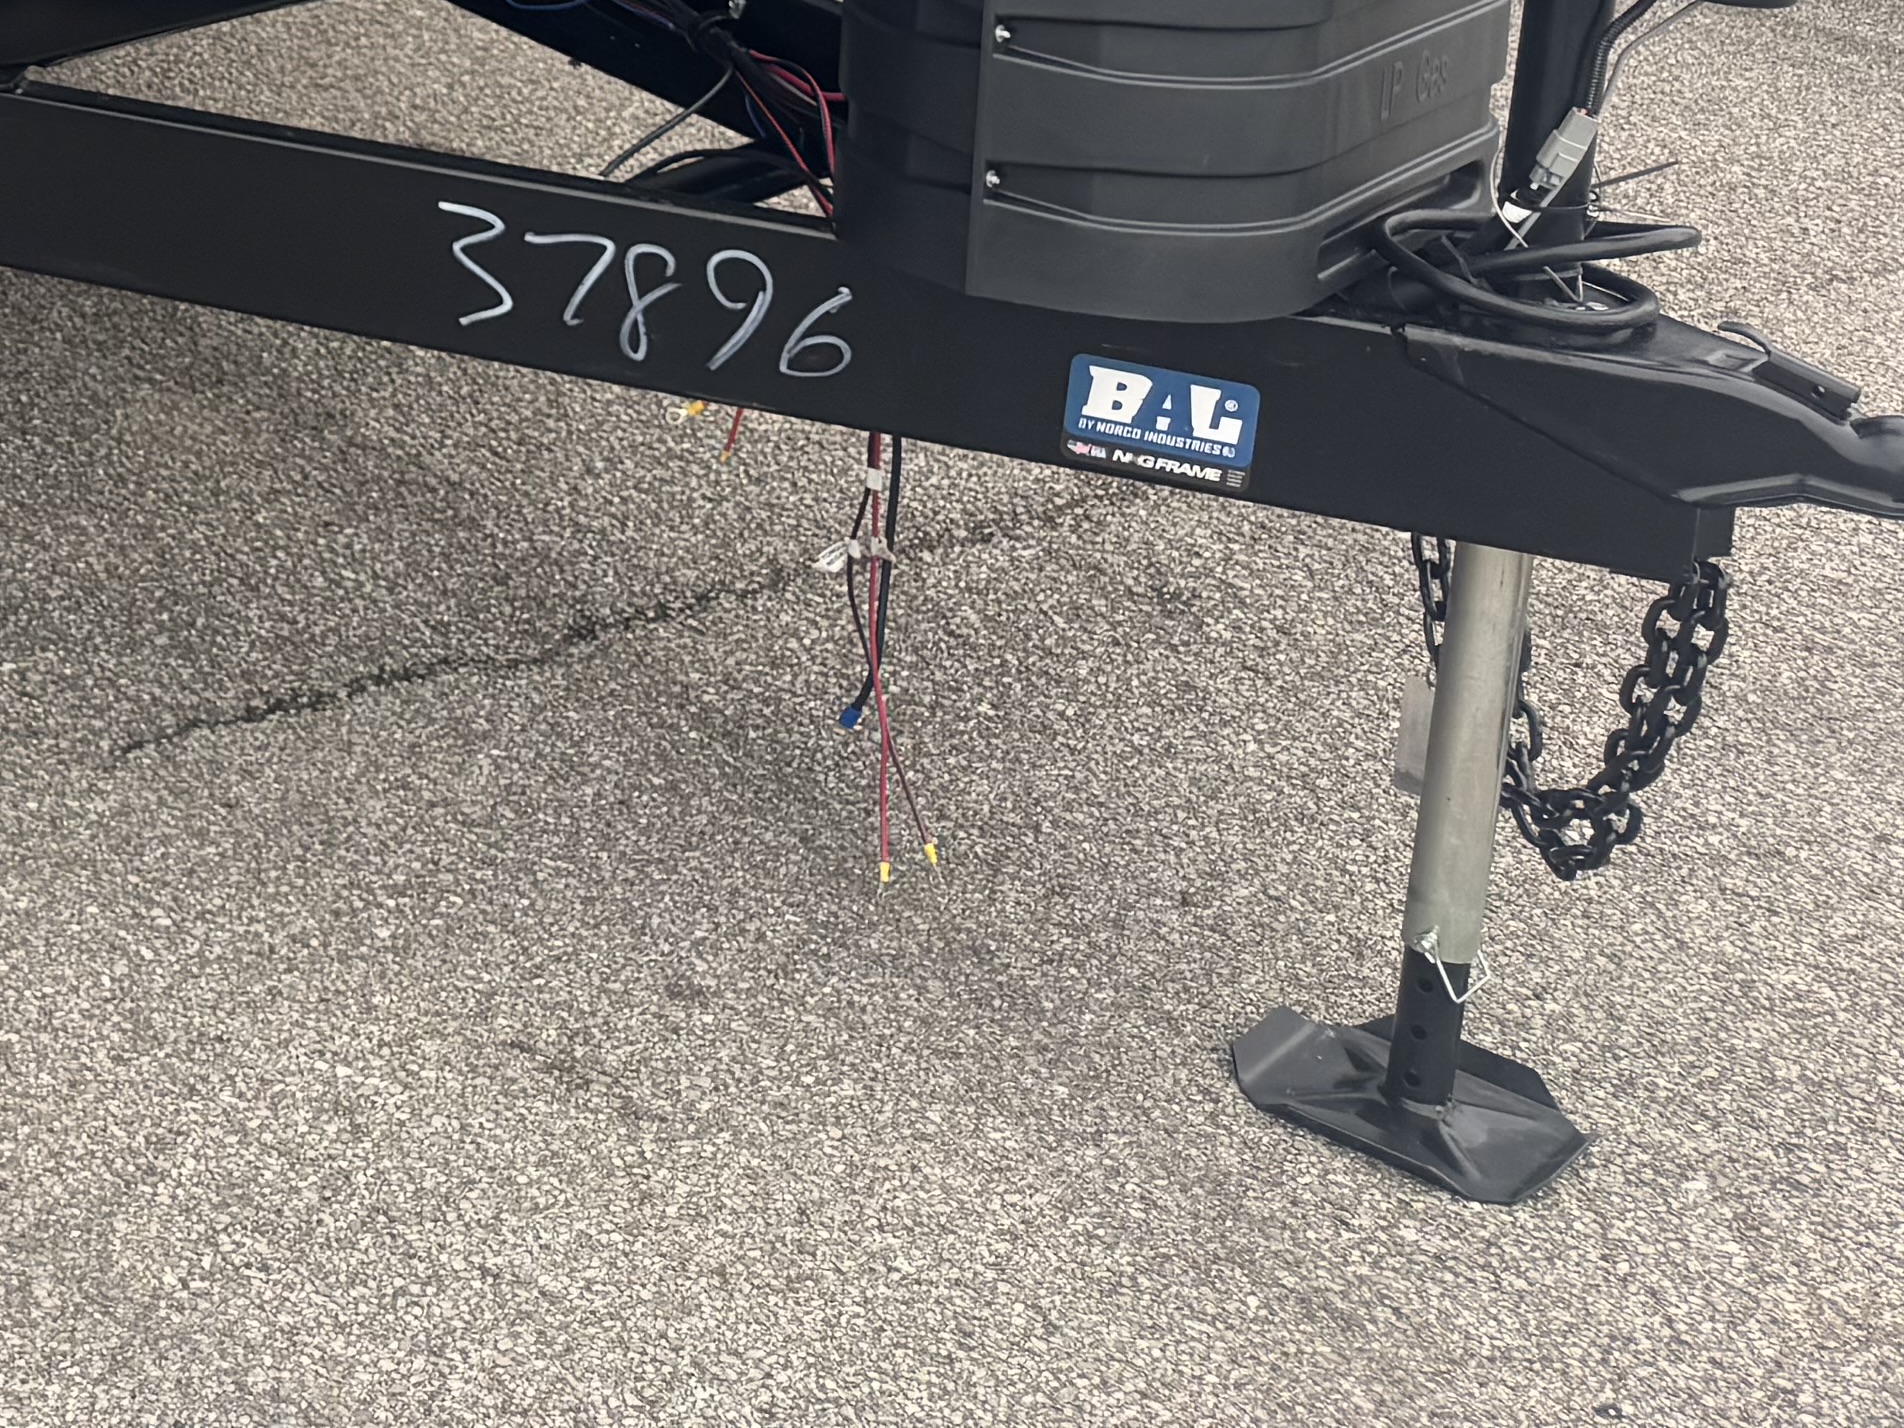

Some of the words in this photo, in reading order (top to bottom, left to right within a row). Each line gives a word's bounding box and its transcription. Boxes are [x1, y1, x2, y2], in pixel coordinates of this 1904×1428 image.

[437, 200, 853, 377] 37896
[1081, 365, 1243, 445] BAL
[1078, 417, 1095, 430] BY
[1096, 421, 1142, 440] NORCO
[1143, 430, 1222, 456] INDUSTRIES
[1155, 458, 1223, 482] FRAME
